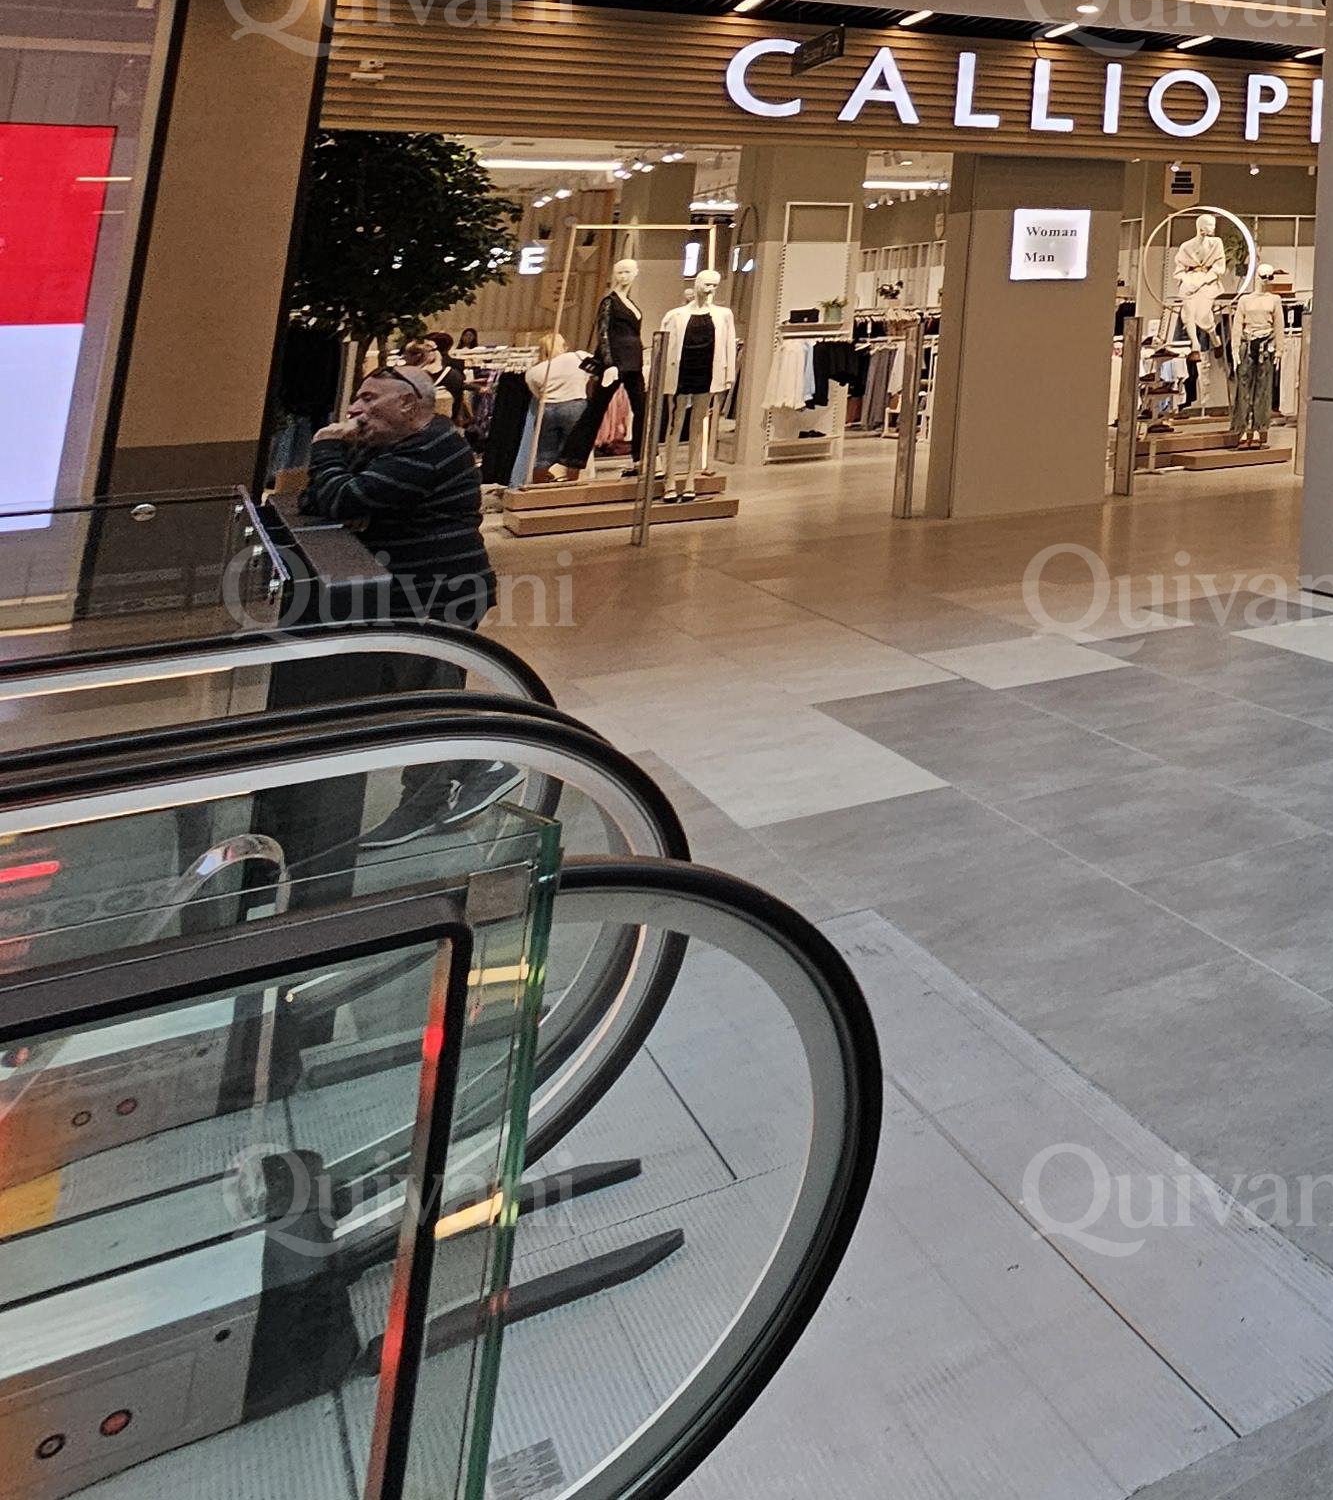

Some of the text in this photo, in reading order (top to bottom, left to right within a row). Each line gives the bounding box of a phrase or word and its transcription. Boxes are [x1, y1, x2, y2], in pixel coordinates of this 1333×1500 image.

[725, 38, 1323, 144] CALLIOP
[1026, 226, 1078, 239] Woman
[1024, 251, 1055, 263] Man
